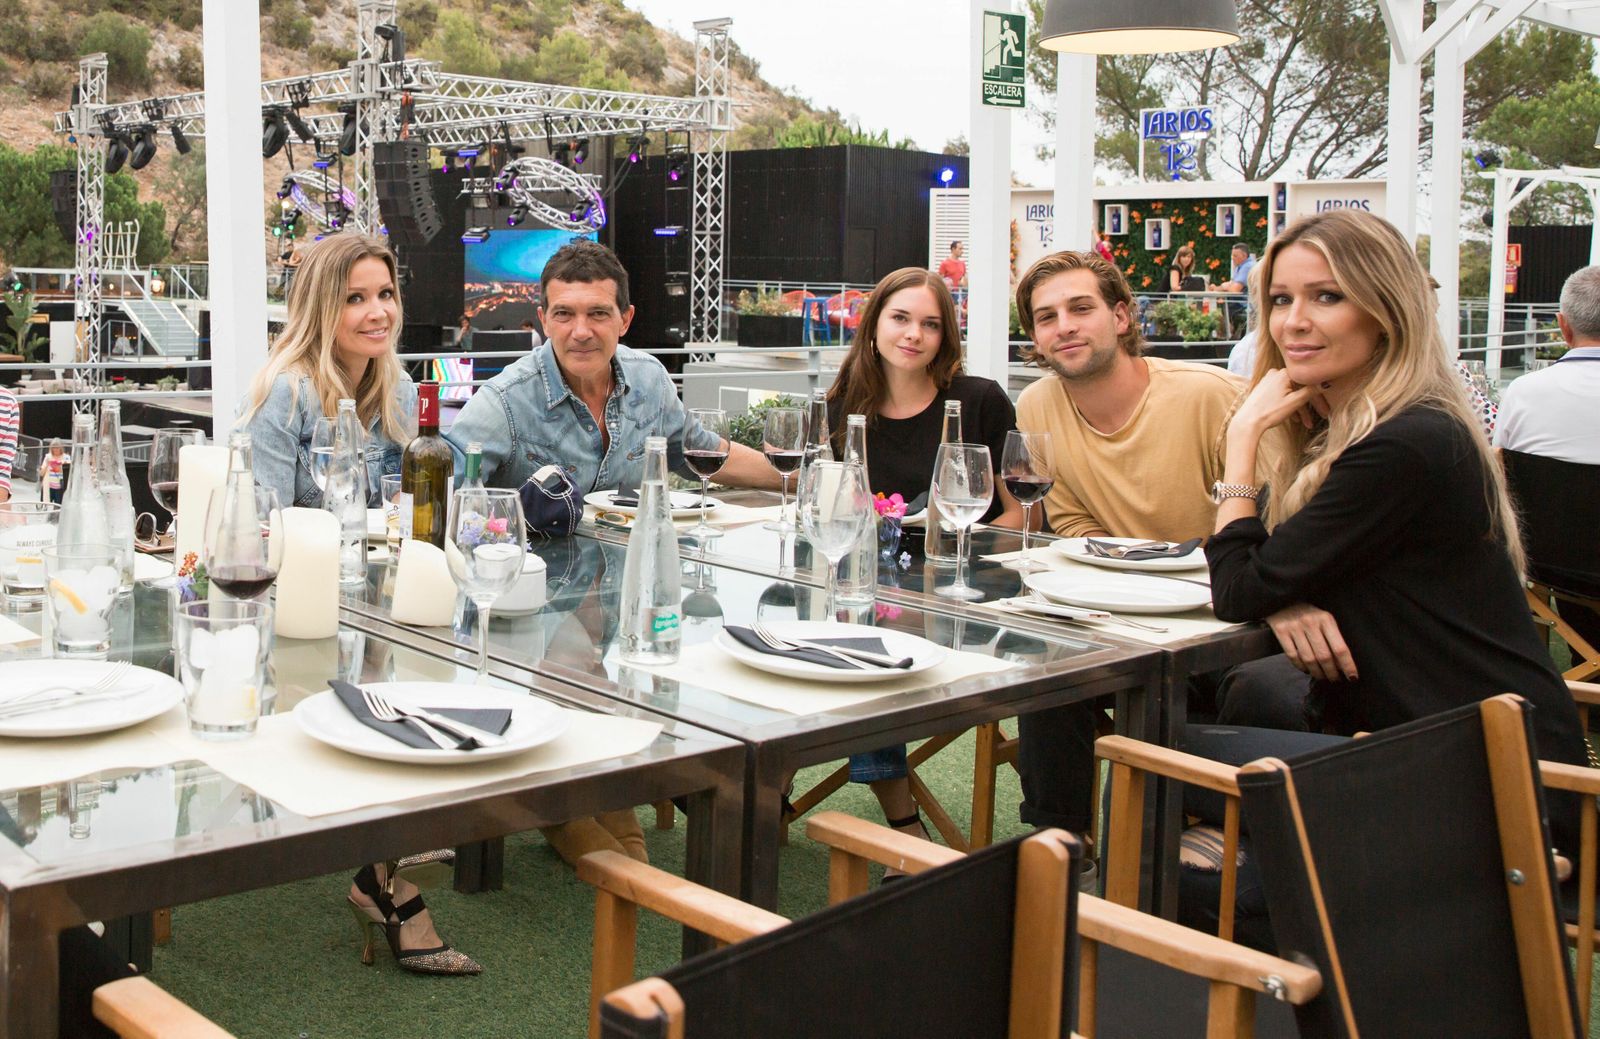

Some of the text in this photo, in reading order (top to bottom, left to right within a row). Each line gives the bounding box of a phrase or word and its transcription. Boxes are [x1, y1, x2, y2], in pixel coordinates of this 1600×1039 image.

[984, 84, 1022, 97] ESCALERA
[1144, 108, 1212, 139] LARIOS
[1160, 142, 1196, 170] 12
[1026, 204, 1054, 222] LARI
